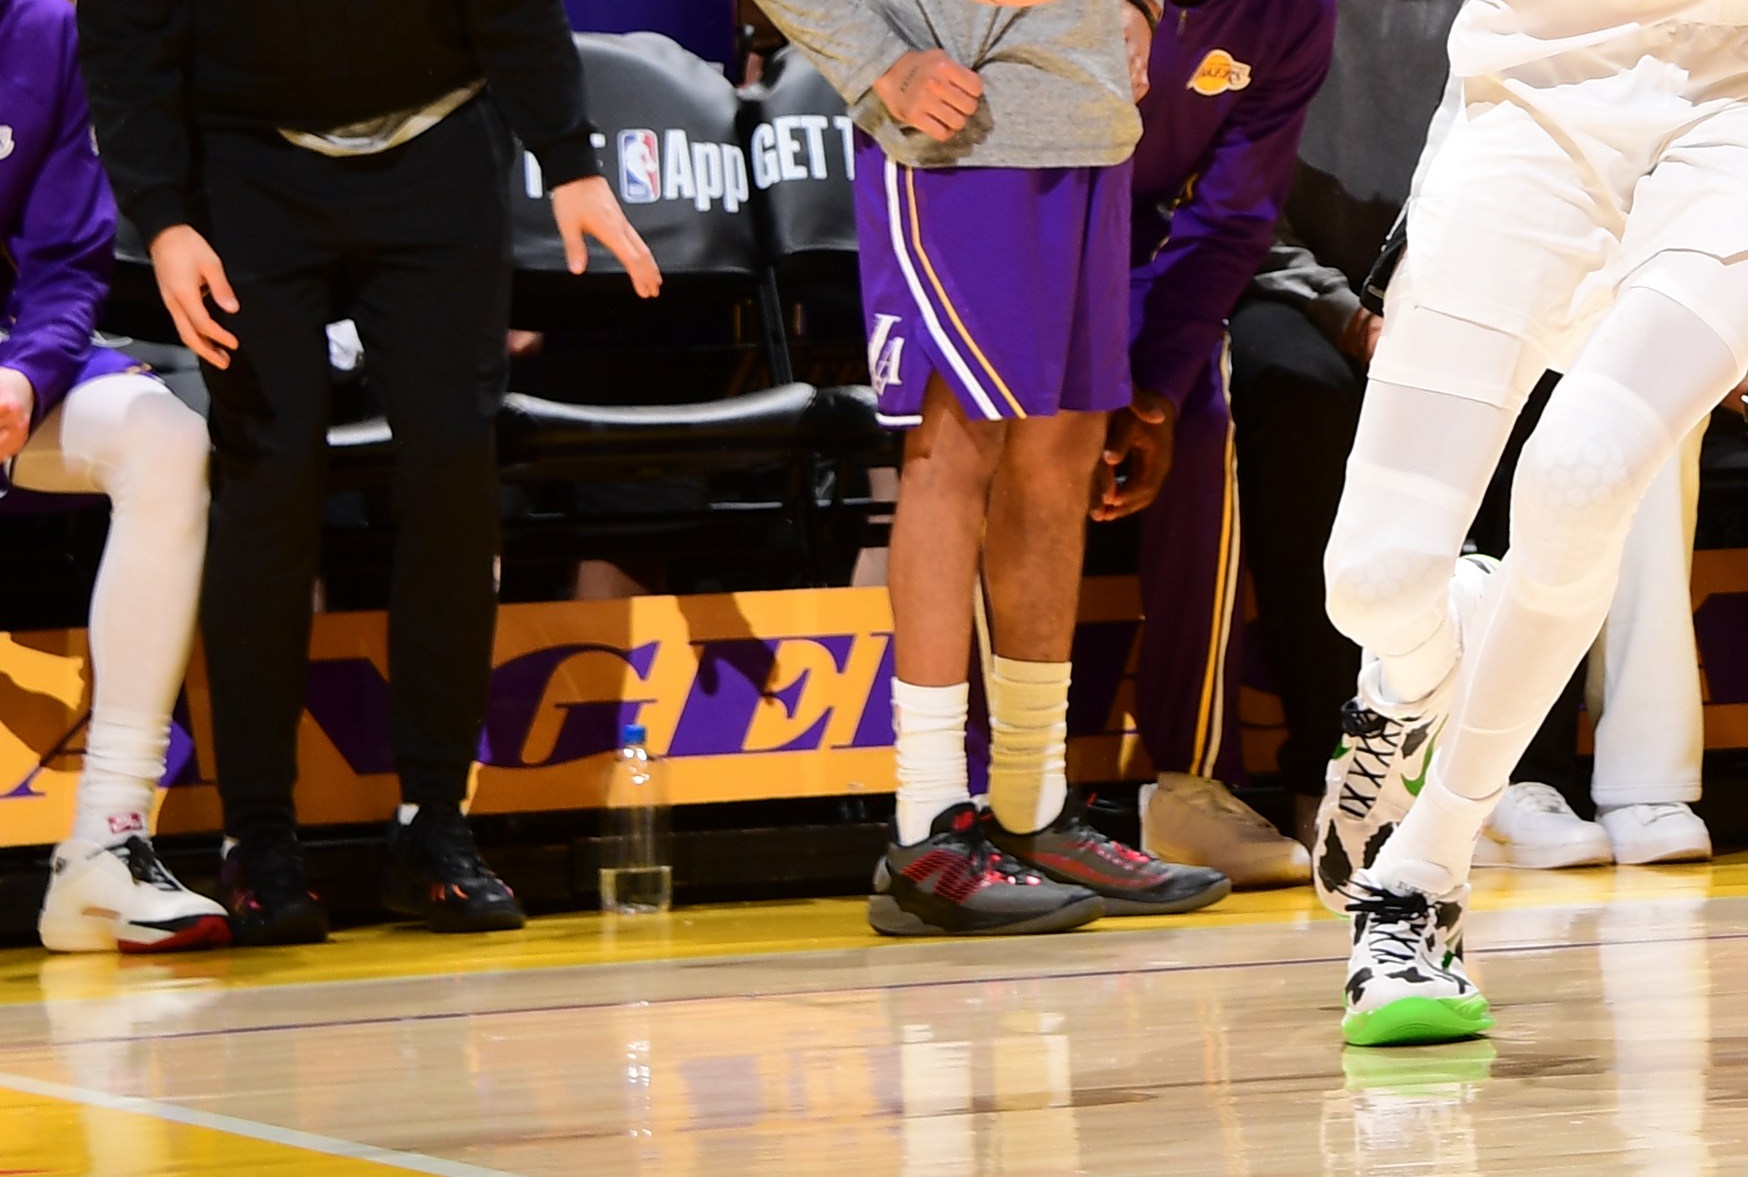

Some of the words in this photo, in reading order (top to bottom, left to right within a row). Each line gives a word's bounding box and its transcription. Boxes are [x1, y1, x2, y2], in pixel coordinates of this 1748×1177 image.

[663, 128, 750, 214] App
[750, 114, 828, 191] GET
[867, 312, 905, 396] LA
